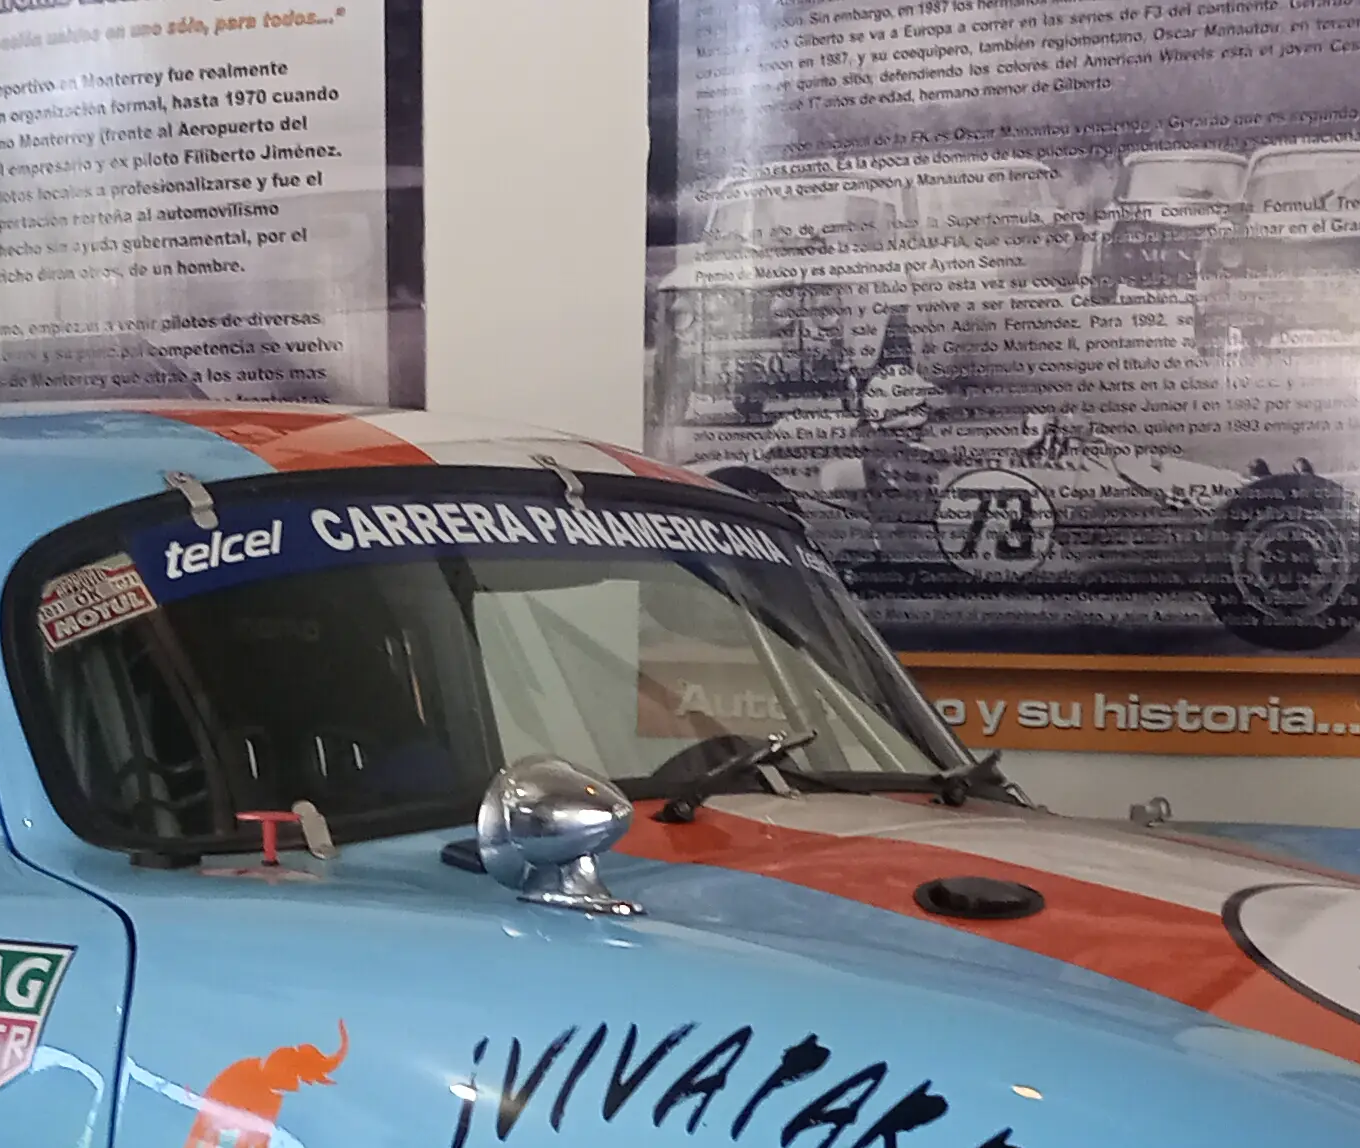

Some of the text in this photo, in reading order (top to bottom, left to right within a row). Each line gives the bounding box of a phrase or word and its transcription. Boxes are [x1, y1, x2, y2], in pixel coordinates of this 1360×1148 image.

[214, 14, 256, 35] para
[795, 33, 844, 48] Gilberto
[849, 31, 864, 42] se
[870, 30, 885, 41] va
[904, 24, 952, 39] Europa
[958, 22, 965, 33] a
[971, 20, 1013, 32] correr
[1043, 13, 1063, 26] las
[1070, 12, 1113, 25] series
[1120, 8, 1138, 22] de
[1168, 4, 1191, 17] del
[809, 13, 829, 25] Sin
[898, 6, 913, 17] en
[799, 39, 1035, 69] en su coequipero, también
[168, 66, 194, 83] fue
[199, 61, 288, 80] realmente
[879, 51, 1152, 84] defendiendo los colores del American
[111, 96, 168, 115] formal,
[172, 93, 219, 110] hasta
[226, 89, 266, 106] 1970
[272, 86, 339, 104] cuando
[919, 82, 1049, 101] hermano menor de
[19, 131, 95, 149] Monterrey
[157, 124, 172, 138] al
[178, 118, 275, 138] Aeropuerto
[280, 116, 307, 131] del
[133, 153, 179, 170] piloto
[184, 148, 256, 164] Filiberto
[260, 144, 342, 161] Jiménez.
[111, 178, 252, 199] profesionalizarse
[256, 177, 266, 192] y
[272, 173, 301, 187] fue
[307, 171, 323, 185] el
[987, 170, 1005, 181] en
[137, 202, 279, 221] al automovilismo
[1313, 220, 1326, 232] el
[122, 230, 252, 253] gubernamental,
[257, 231, 287, 248] por
[291, 228, 307, 242] el
[153, 262, 172, 275] un
[177, 260, 245, 275] hombre.
[905, 259, 927, 274] por
[930, 257, 975, 273] Ayrton
[913, 281, 942, 294] pero
[948, 279, 976, 291] esta
[981, 299, 1003, 310] ser
[160, 312, 321, 333] pilotos de diversas
[1091, 315, 1123, 330] Para
[150, 337, 343, 359] competencia se vuelve
[1086, 336, 1178, 350] prontamente
[1039, 356, 1182, 372] consigue el de
[32, 373, 108, 389] Monterrey
[112, 371, 141, 385] que
[208, 368, 231, 383] los
[237, 368, 284, 381] autos
[1141, 379, 1157, 391] en
[957, 487, 1035, 561] 73
[165, 520, 283, 579] telcel
[311, 502, 532, 551] CARRERA
[529, 505, 792, 566] PANAMERICANA
[56, 591, 145, 640] MOTUL
[980, 698, 1006, 734] y
[1018, 697, 1081, 731] su
